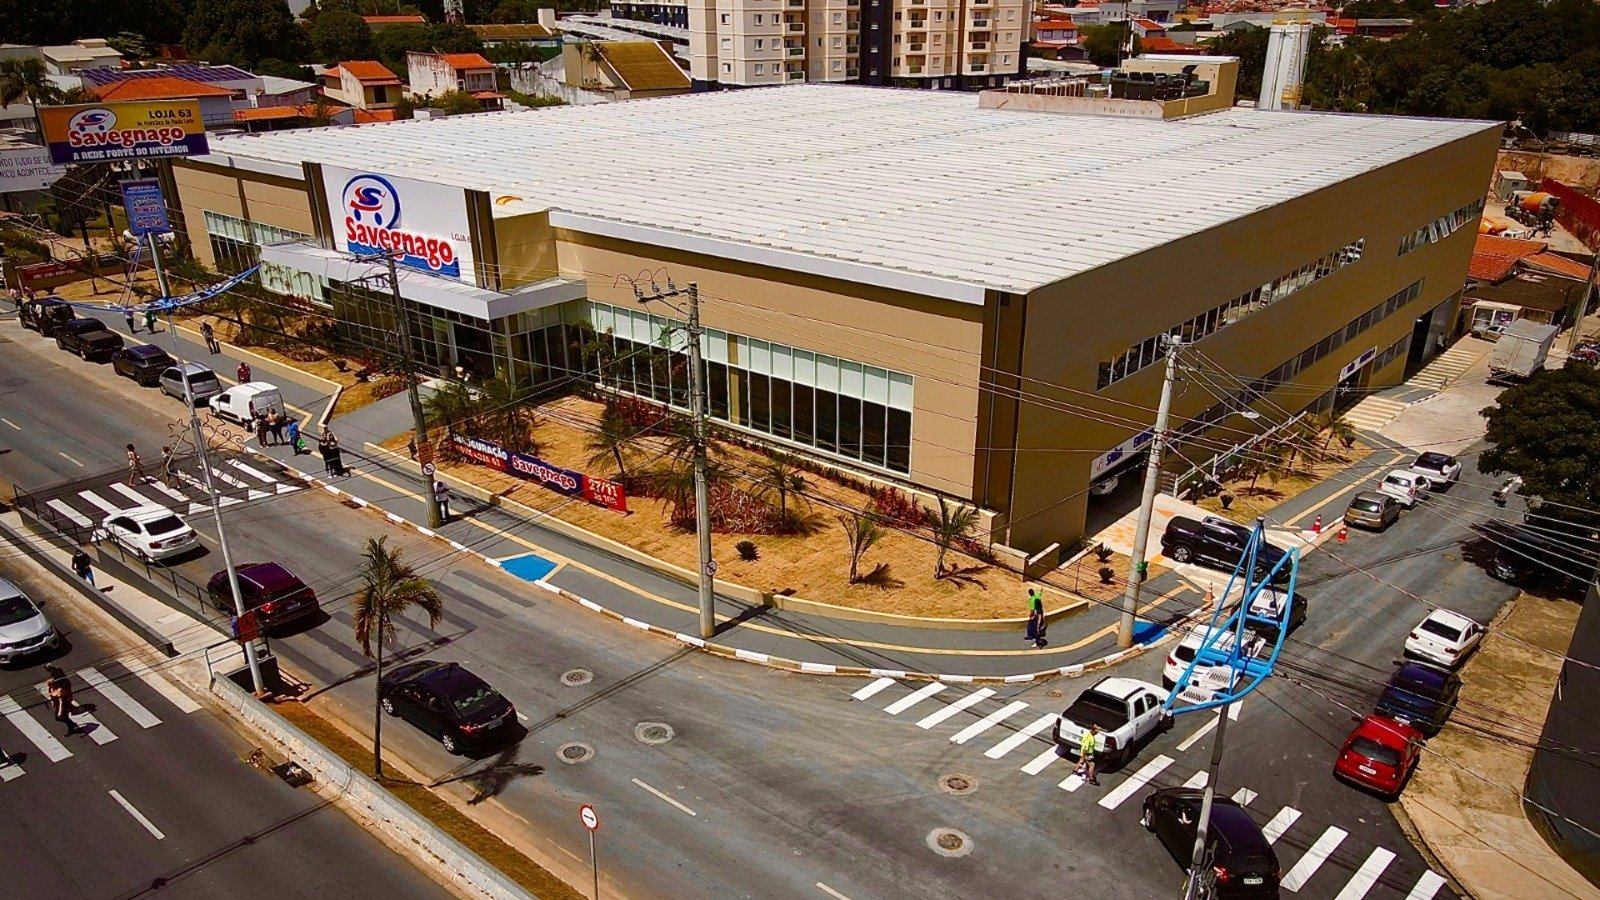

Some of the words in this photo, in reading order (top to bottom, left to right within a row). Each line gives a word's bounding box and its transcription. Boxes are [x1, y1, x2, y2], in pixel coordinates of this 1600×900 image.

[149, 110, 176, 119] LOJA
[178, 109, 192, 118] 63
[68, 127, 185, 148] Savegnago
[73, 152, 80, 160] A
[81, 150, 105, 160] REDE
[106, 148, 135, 158] FORTE
[136, 147, 148, 157] DO
[149, 145, 189, 156] INTERIOR
[33, 156, 42, 165] SE
[345, 215, 454, 269] Savegnago
[451, 232, 466, 241] LOJA
[491, 457, 501, 467] 63
[511, 455, 577, 490] Savegnago
[588, 478, 618, 497] 27/11
